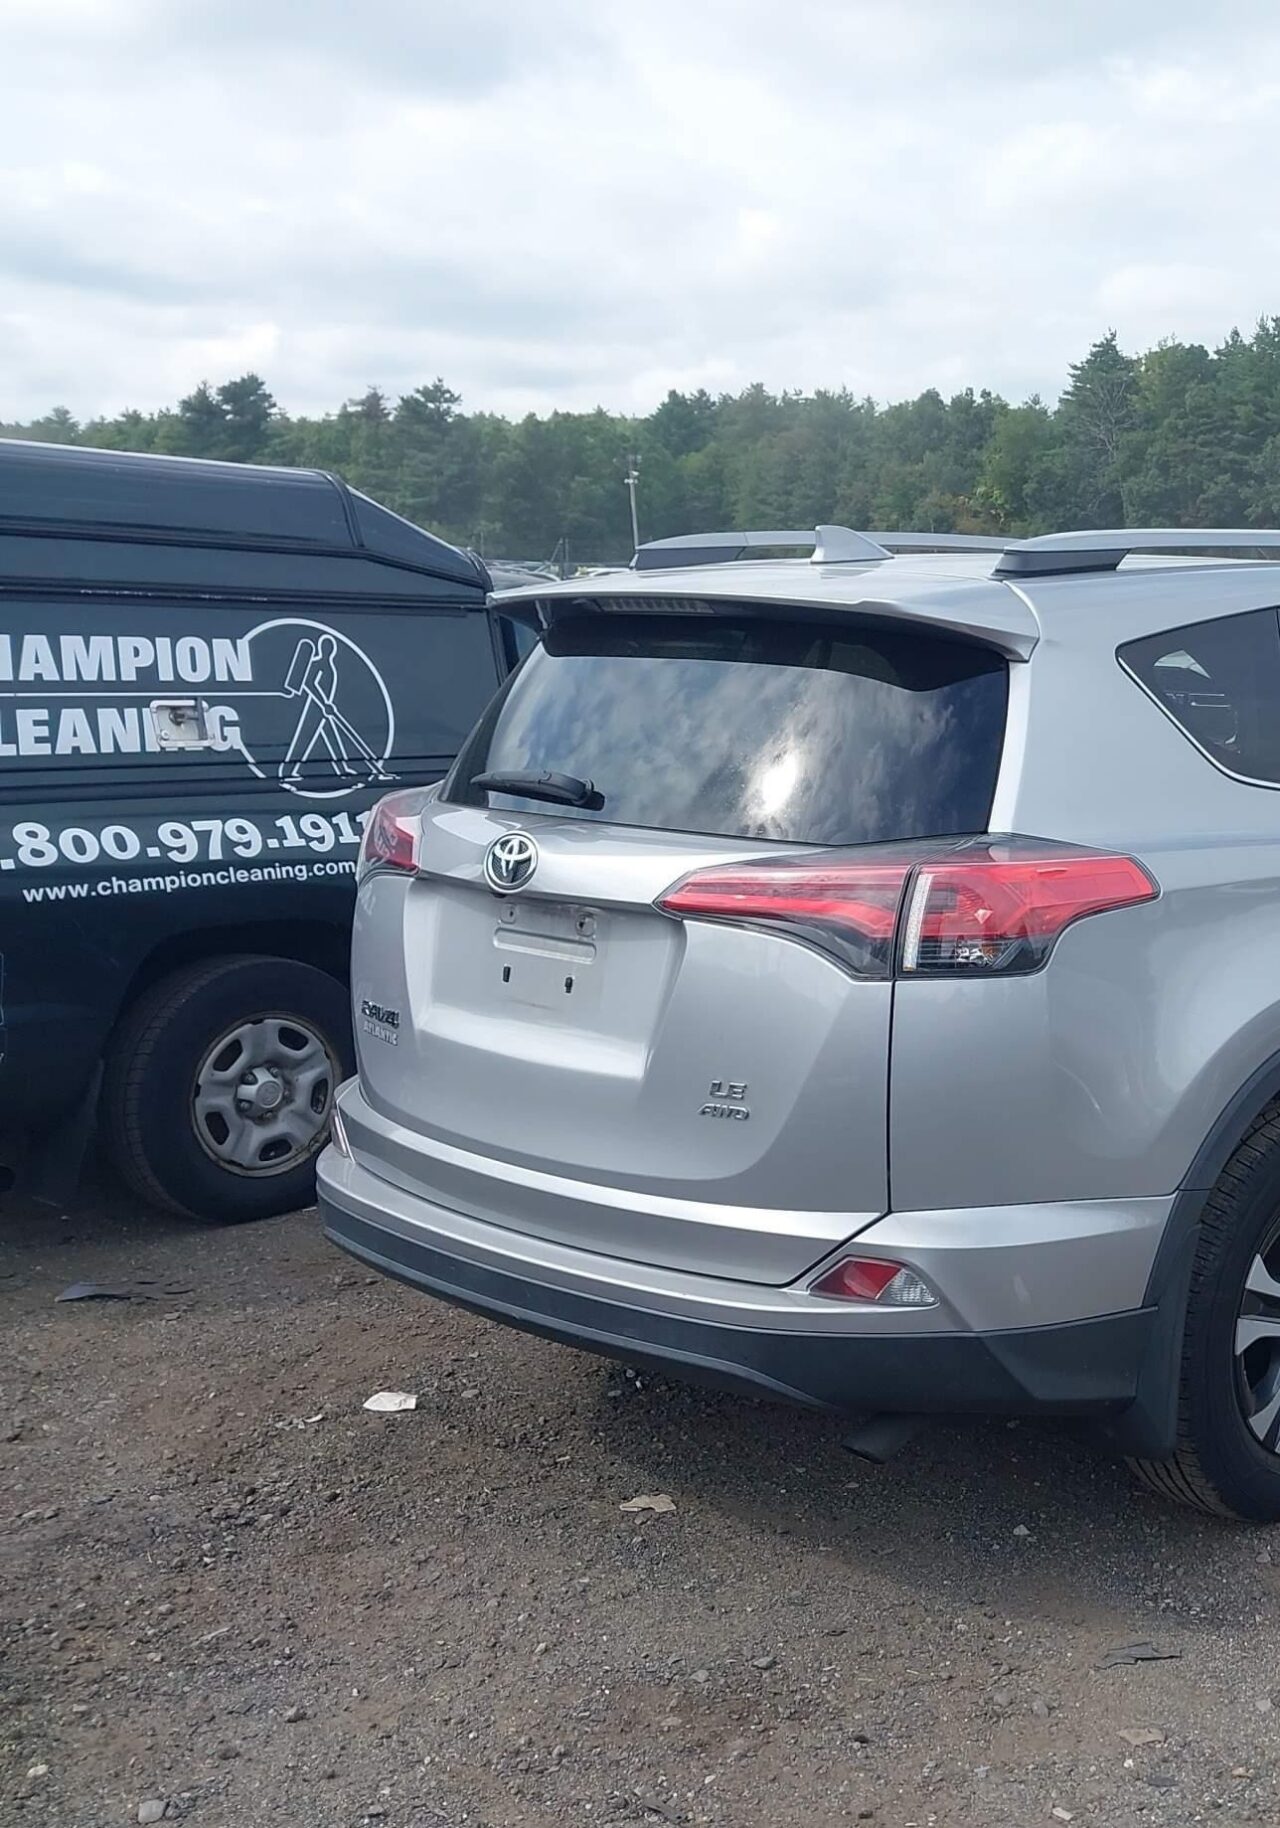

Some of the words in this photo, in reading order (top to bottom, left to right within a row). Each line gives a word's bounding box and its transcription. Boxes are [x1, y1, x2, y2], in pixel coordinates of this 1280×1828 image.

[23, 861, 356, 902] www.championcleaning.com
[361, 1000, 399, 1029] RAV4
[710, 1080, 747, 1100] LE
[698, 1103, 750, 1120] AWD
